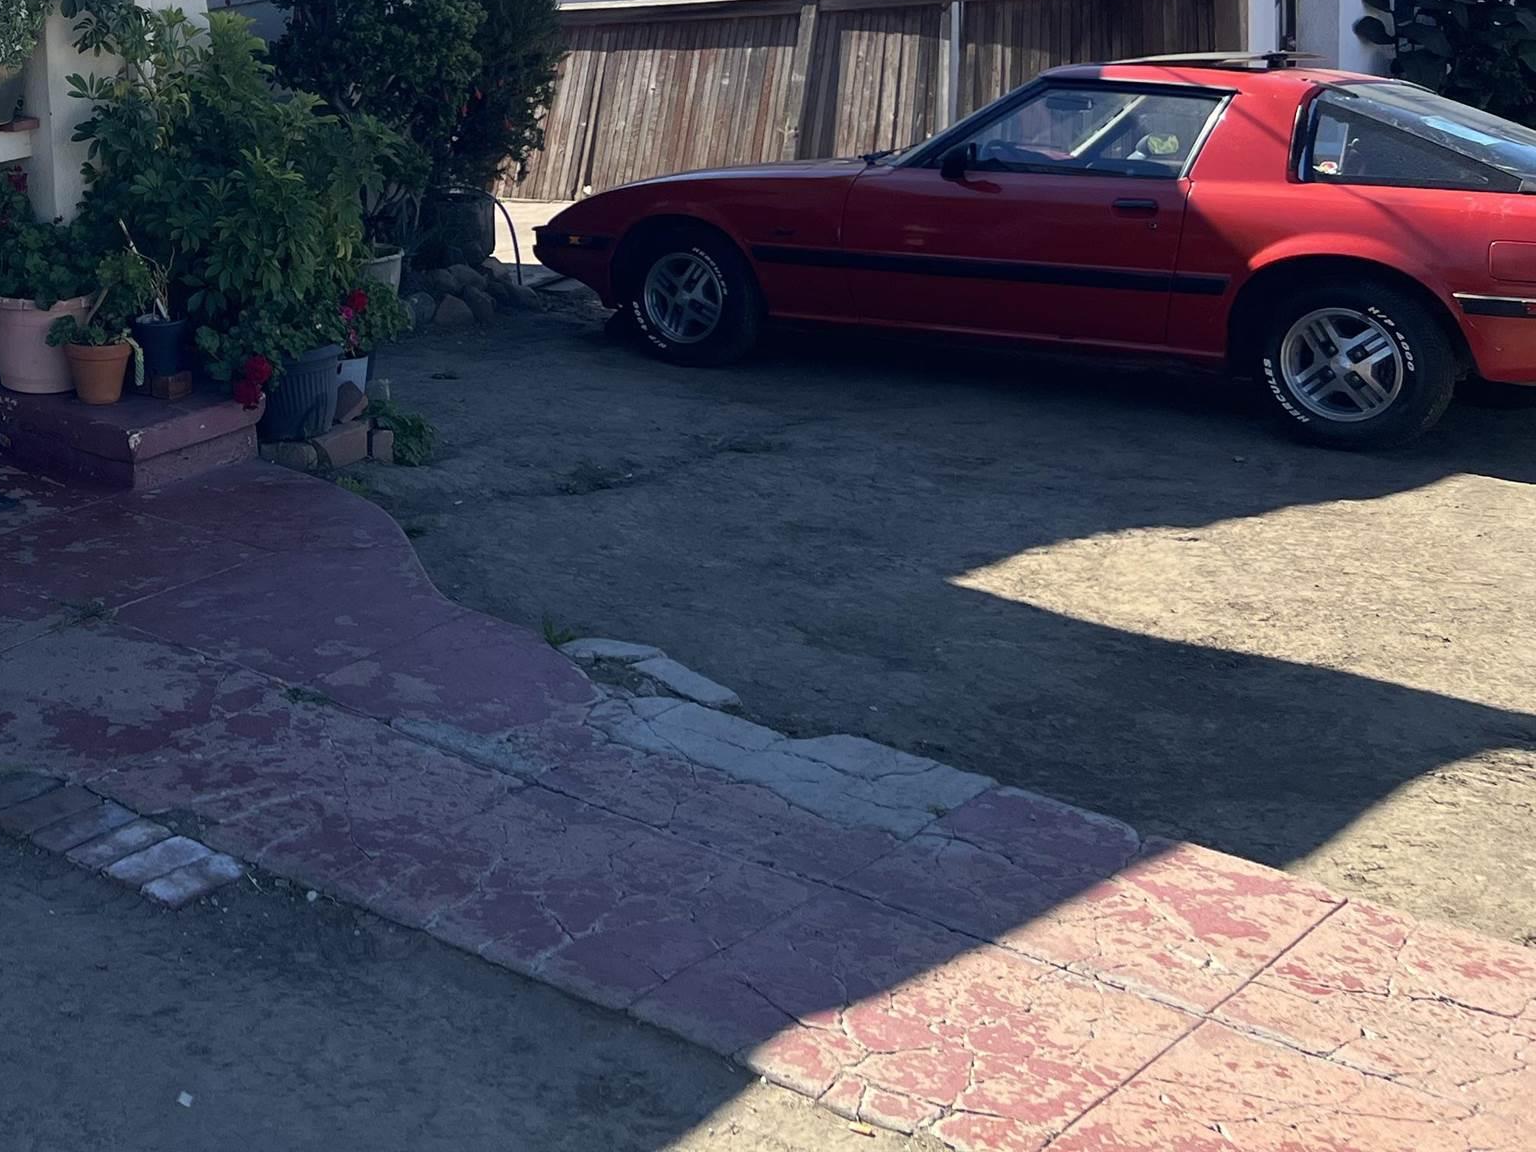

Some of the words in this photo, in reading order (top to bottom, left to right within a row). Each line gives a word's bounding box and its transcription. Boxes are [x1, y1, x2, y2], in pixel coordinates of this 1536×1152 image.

[1367, 306, 1396, 327] H/P
[1395, 331, 1415, 372] 4000
[1263, 358, 1311, 423] HERCULES
